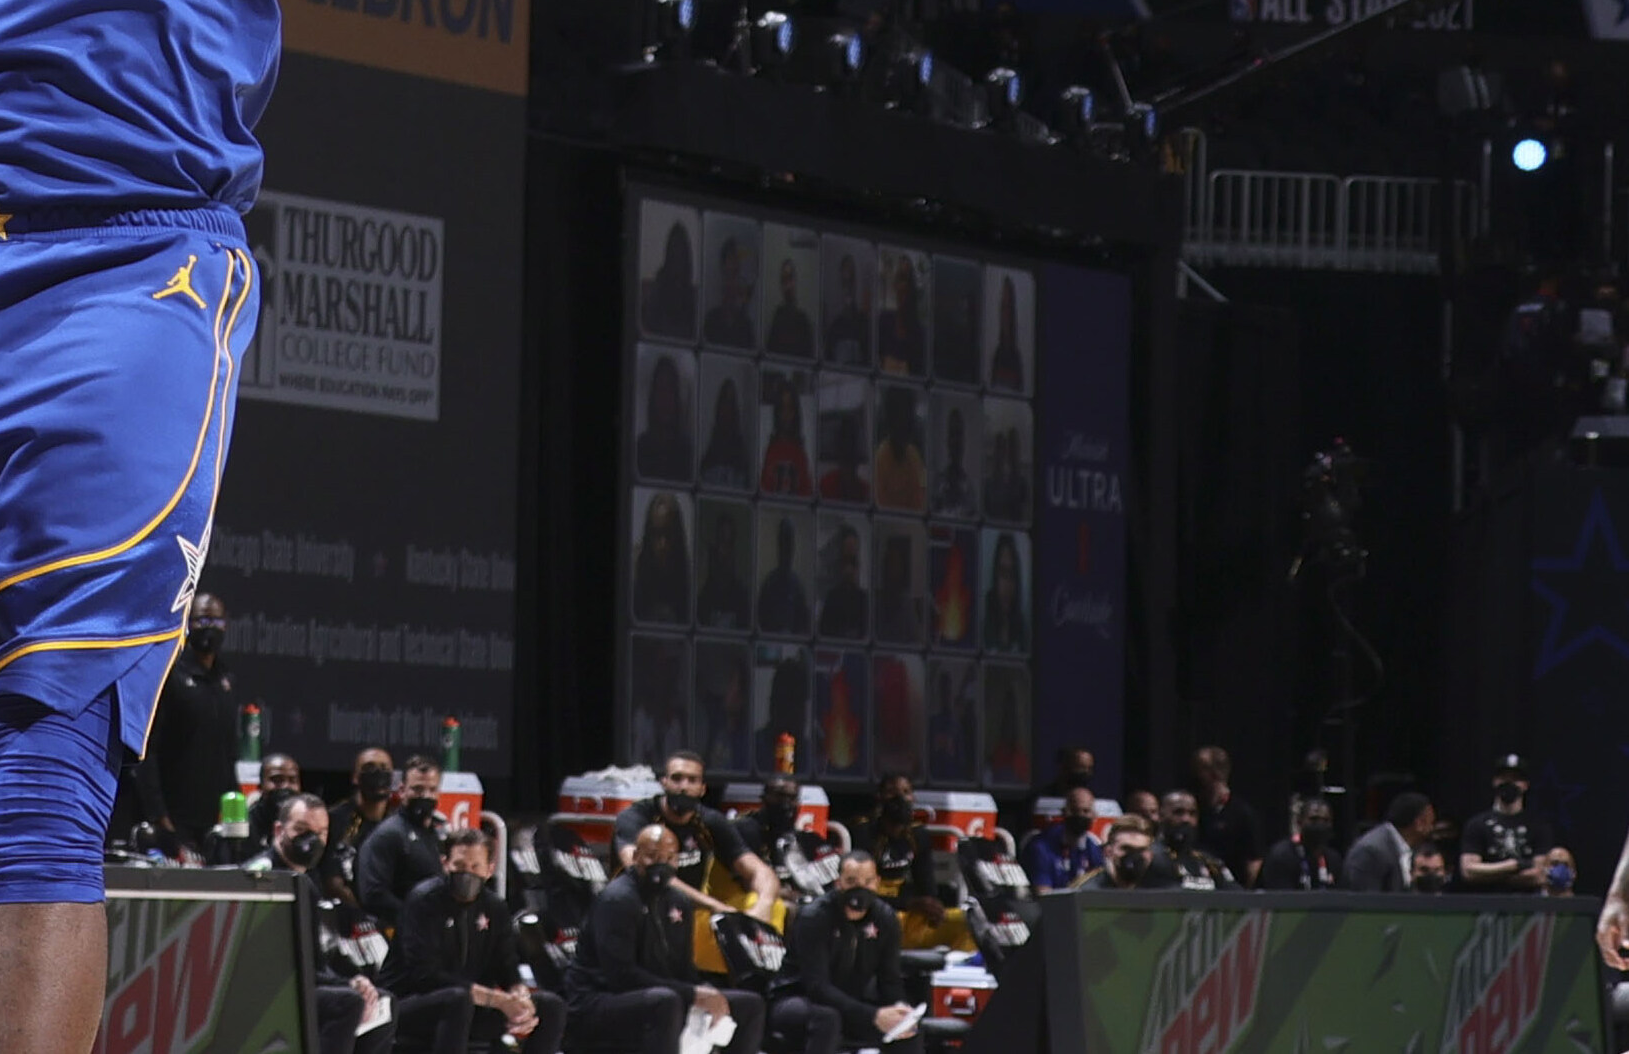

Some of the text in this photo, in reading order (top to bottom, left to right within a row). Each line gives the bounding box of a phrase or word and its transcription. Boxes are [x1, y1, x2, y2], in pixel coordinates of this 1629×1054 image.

[282, 205, 438, 283] THURGOOD
[280, 270, 435, 345] MARSHALL
[281, 332, 436, 380] COLLEGE FUND
[1048, 466, 1124, 514] ULTRA
